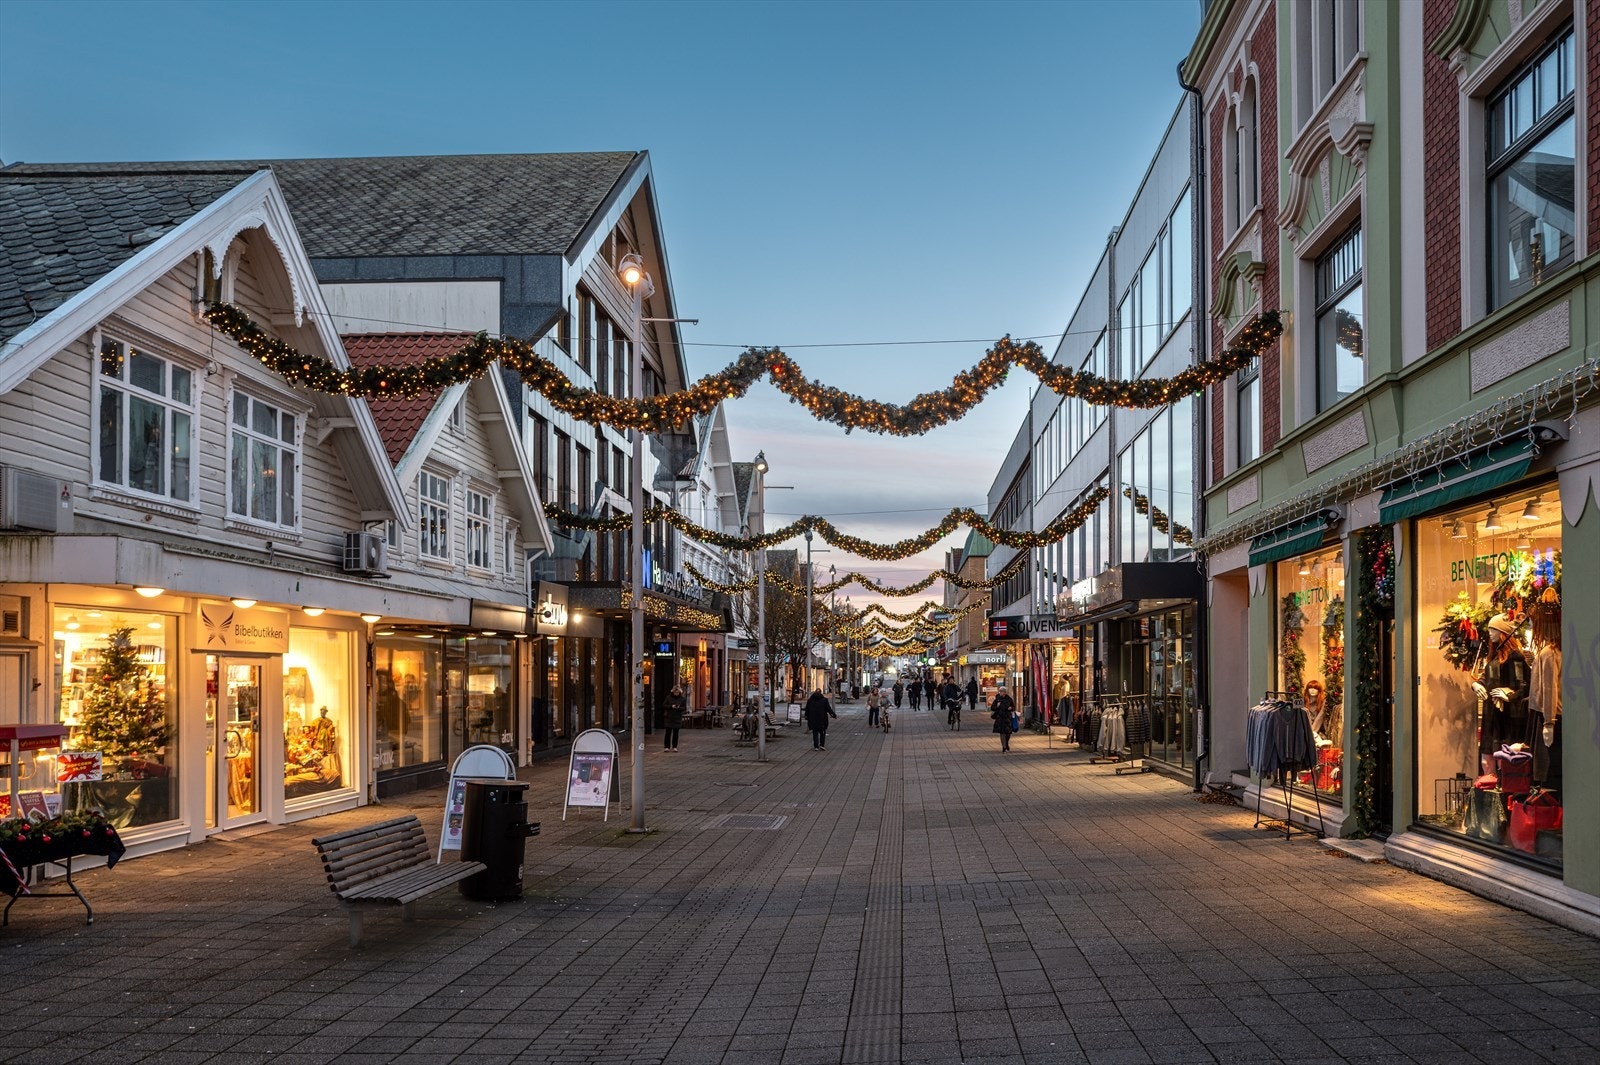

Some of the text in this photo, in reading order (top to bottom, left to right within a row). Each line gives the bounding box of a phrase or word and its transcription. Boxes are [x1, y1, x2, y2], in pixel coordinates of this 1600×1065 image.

[1451, 550, 1520, 582] BENETTON
[1294, 587, 1330, 607] BENETTON
[235, 624, 283, 639] Bibelbutikken
[985, 655, 1006, 663] norli
